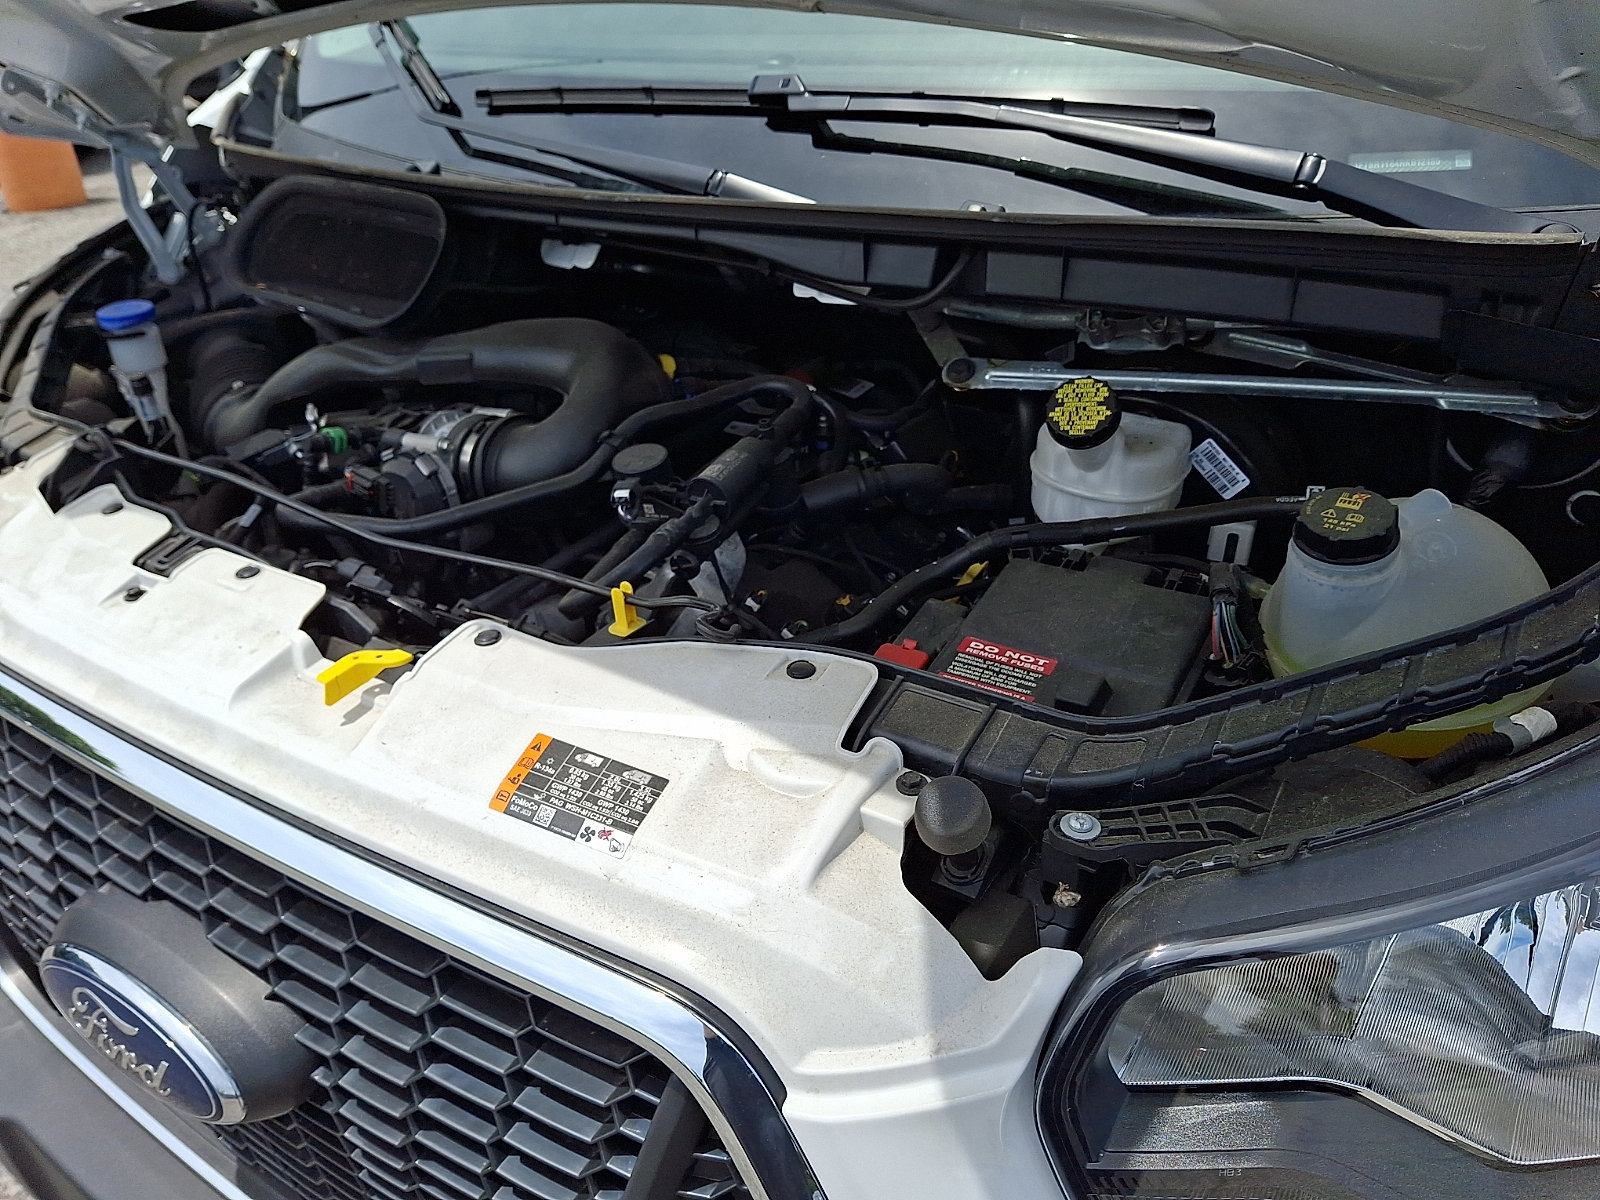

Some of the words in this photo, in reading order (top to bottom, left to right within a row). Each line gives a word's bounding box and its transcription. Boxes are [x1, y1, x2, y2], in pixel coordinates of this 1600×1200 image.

[965, 647, 1009, 663] REMOVE
[1011, 659, 1045, 672] FUSES
[969, 641, 1000, 654] DO
[1005, 650, 1050, 666] NOT
[953, 666, 982, 677] MINIMUM
[957, 652, 985, 663] REMOVAL
[994, 662, 1014, 671] FUSES
[1014, 667, 1028, 675] WILL
[1029, 671, 1043, 679] NOT
[946, 668, 980, 681] TAMPERING
[980, 677, 996, 686] WITH
[995, 682, 1032, 695] EQUIPMENT.
[951, 661, 984, 674] VIOLATORS
[983, 669, 998, 677] WILL
[1007, 676, 1037, 688] CHARGED
[534, 762, 556, 775] R-134a
[581, 770, 590, 781] kg
[551, 782, 568, 792] GWP
[568, 787, 583, 798] 1430
[613, 784, 622, 793] kg
[511, 795, 538, 811] FoMoCo
[644, 794, 654, 804] kg
[509, 804, 520, 813] SAE
[548, 797, 565, 807] PAG
[565, 801, 614, 825] WSH-M1C231-B
[597, 799, 614, 809] GWP
[614, 805, 630, 816] 1430
[67, 987, 171, 1097] Ford
